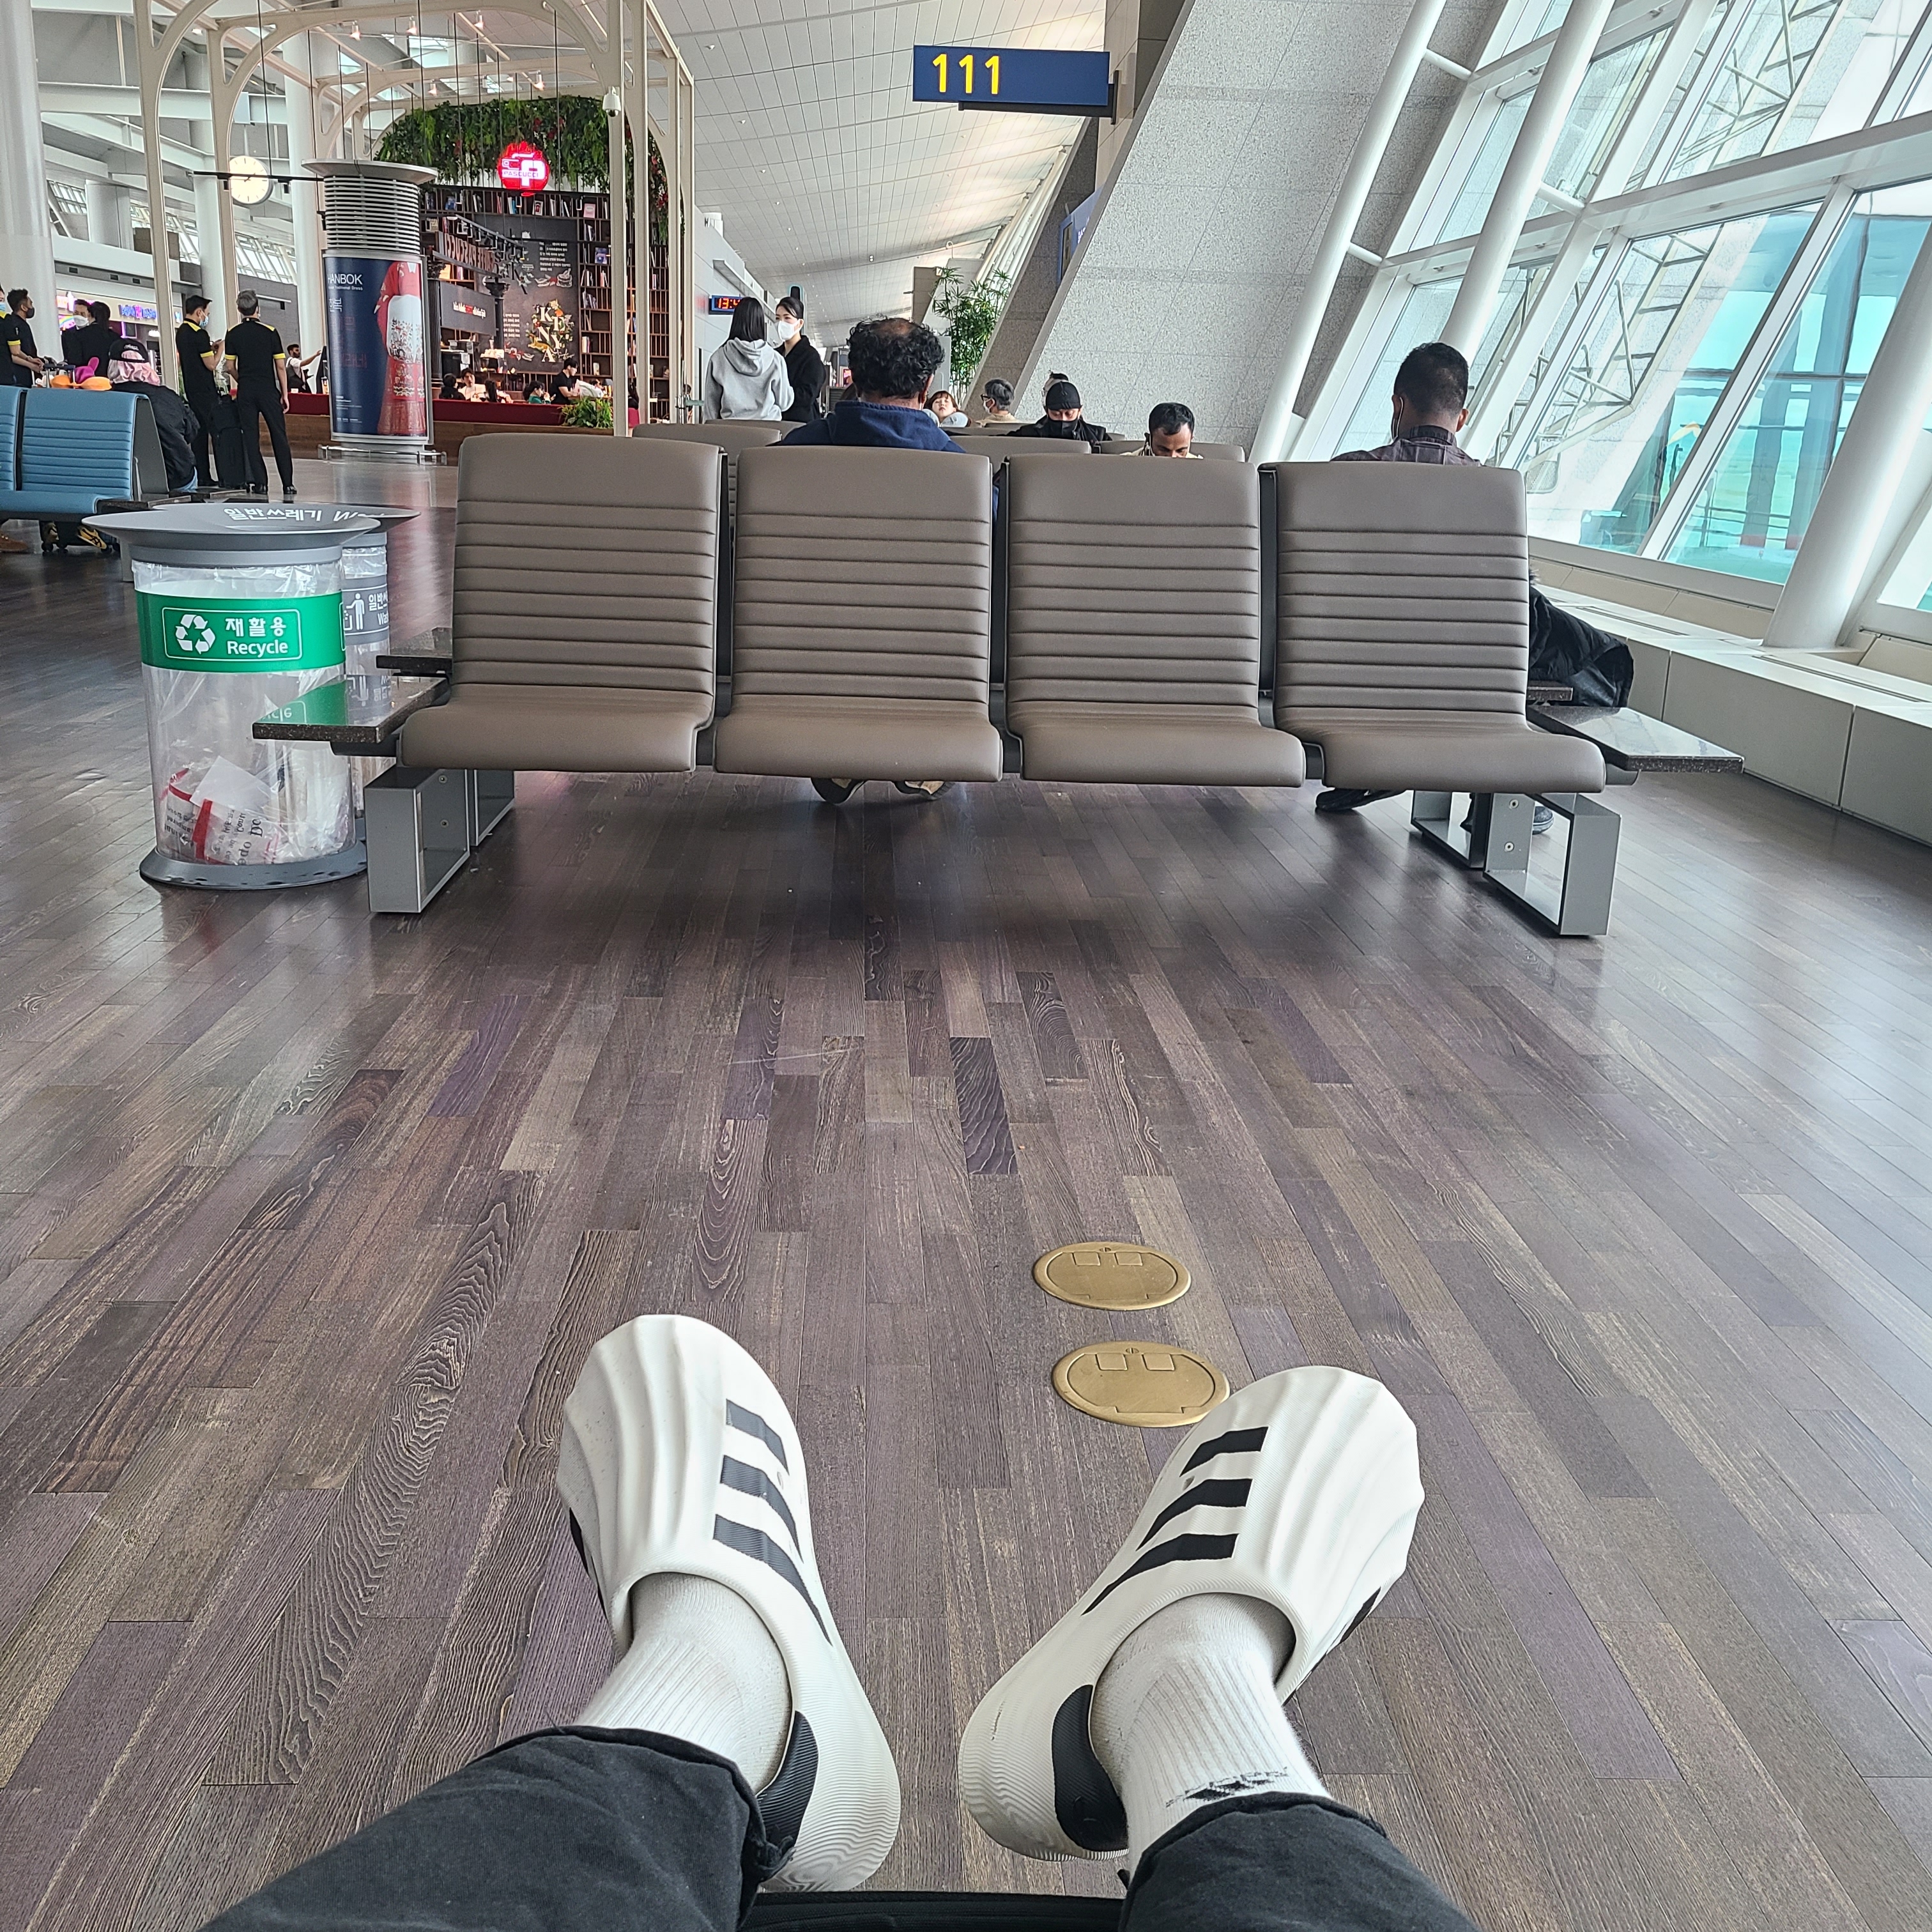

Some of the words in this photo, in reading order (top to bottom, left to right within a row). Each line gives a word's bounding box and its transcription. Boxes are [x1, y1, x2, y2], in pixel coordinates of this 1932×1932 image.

[933, 54, 999, 95] 111
[327, 273, 363, 285] HANBOK
[329, 298, 342, 312] 한복
[718, 297, 740, 309] 13:4
[224, 508, 322, 522] 일반쓰레기
[225, 617, 287, 637] 재활용
[227, 640, 288, 658] Recycle
